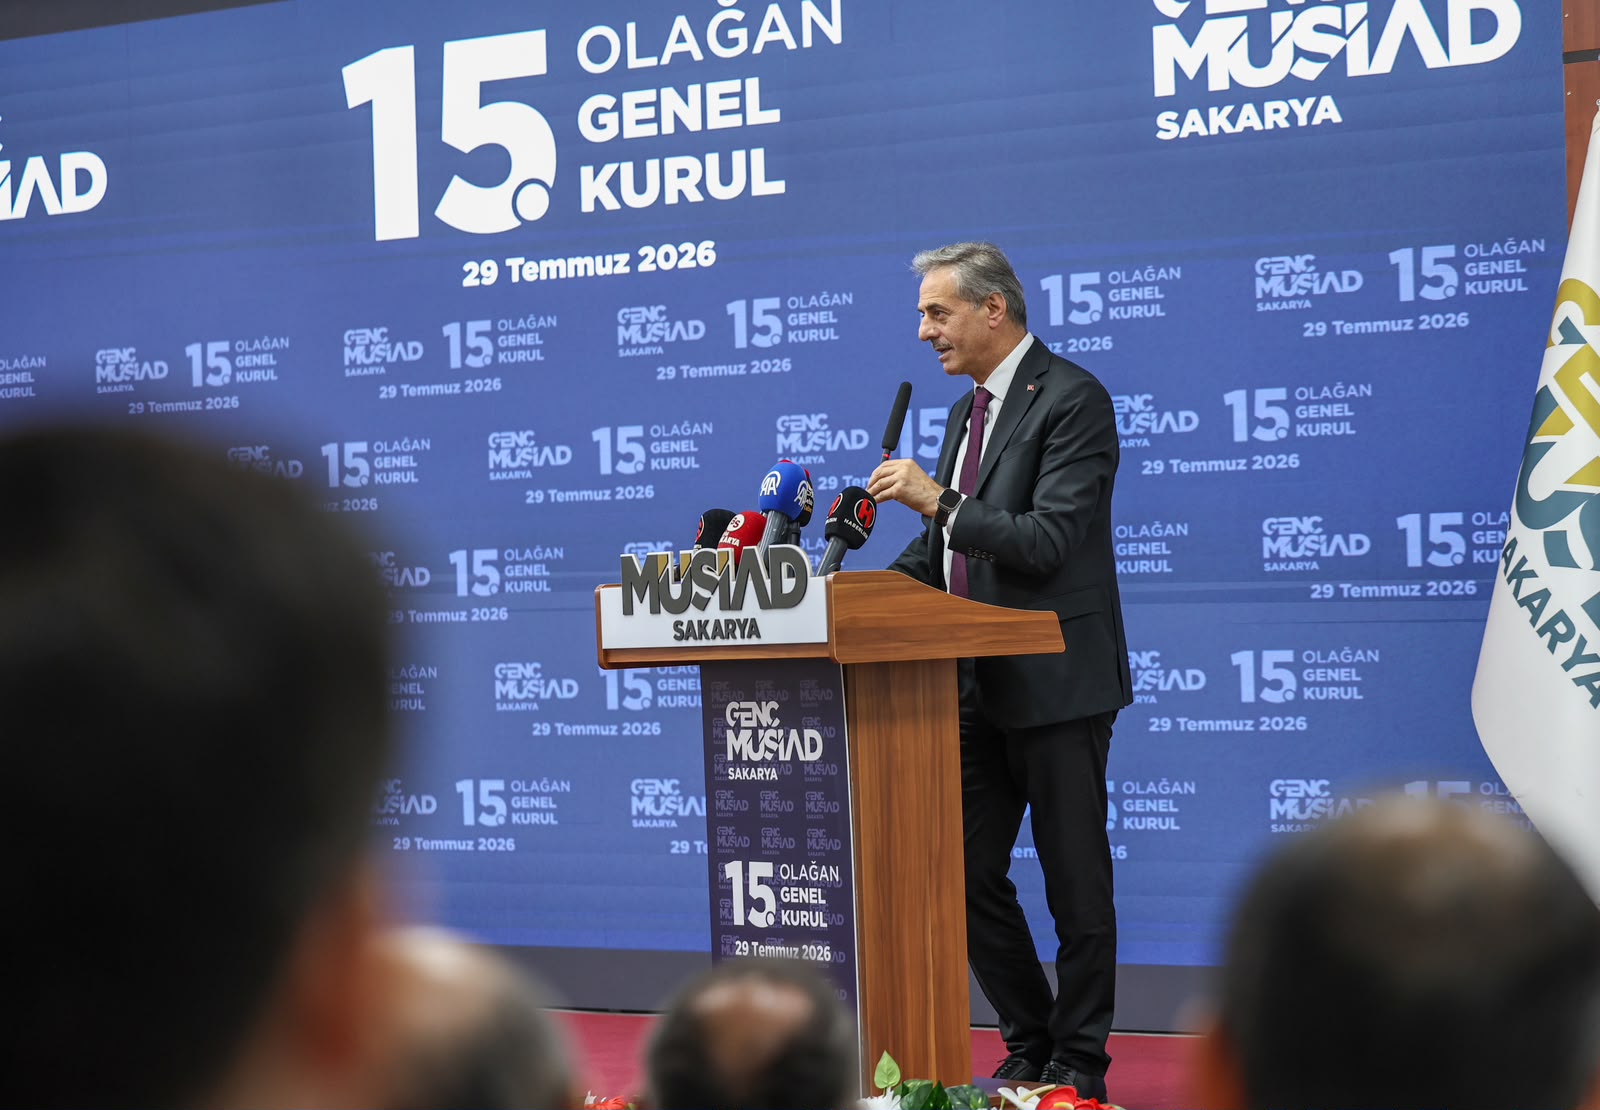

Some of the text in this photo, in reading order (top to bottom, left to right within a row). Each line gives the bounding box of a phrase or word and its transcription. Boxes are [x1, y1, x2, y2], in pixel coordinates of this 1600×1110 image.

[576, 0, 843, 74] OLAĞAN
[577, 77, 781, 143] GENEL
[1156, 95, 1343, 141] SAKARYA
[580, 147, 786, 213] KURUL
[1464, 238, 1544, 257] OLAĞAN
[462, 240, 717, 288] 29 Temmuz 2026
[1465, 260, 1526, 276] GENEL
[1108, 266, 1180, 284] OLAĞAN
[1466, 278, 1528, 294] KURUL
[788, 292, 852, 309] OLAĞAN
[1109, 286, 1164, 302] GENEL
[1109, 304, 1166, 320] KURUL
[1257, 300, 1312, 311] SAKARYA
[498, 314, 556, 331] OLAĞAN
[788, 311, 838, 326] GENEL
[1304, 312, 1469, 336] 29 Temmuz 2026
[498, 332, 543, 347] GENEL
[788, 328, 839, 342] KURUL
[235, 336, 289, 352] OLAĞAN
[618, 346, 664, 357] SAKARYA
[1068, 336, 1112, 352] 2026
[236, 354, 276, 367] GENEL
[499, 349, 544, 363] KURUL
[236, 369, 278, 382] KURUL
[345, 366, 386, 376] SAKARYA
[657, 358, 791, 380] 29 Temmuz 2026
[97, 385, 134, 394] SAKARYA
[380, 378, 501, 398] 29 Temmuz 2026
[1295, 382, 1372, 400] OLAĞAN
[129, 396, 239, 414] 29 Temmuz 2026
[1296, 404, 1354, 418] GENEL
[650, 421, 712, 437] OLAĞAN
[1296, 422, 1356, 436] KURUL
[374, 437, 430, 453] OLAĞAN
[650, 440, 698, 453] GENEL
[374, 456, 417, 468] GENEL
[651, 456, 700, 470] KURUL
[1142, 454, 1300, 474] 29 Temmuz 2026
[375, 471, 418, 484] KURUL
[490, 470, 532, 480] SAKARYA
[818, 476, 838, 490] 29
[526, 485, 654, 503] 29 Temmuz 2026
[344, 498, 378, 510] 2026
[1472, 511, 1509, 526] OLA
[1115, 521, 1188, 538] OLAĞAN
[1472, 530, 1506, 544] GEN
[504, 545, 563, 561] OLAĞAN
[1116, 542, 1171, 556] GENEL
[505, 564, 550, 577] GENEL
[1116, 560, 1172, 574] KURUL
[1264, 562, 1319, 572] SAKARYA
[505, 580, 551, 592] KURUL
[1310, 580, 1476, 598] 29 Temmuz 2026
[408, 610, 467, 622] Temmuz
[472, 607, 508, 621] 2026
[672, 618, 761, 641] SAKARYA
[1502, 536, 1600, 709] AKARYA
[1302, 647, 1379, 663] OLAĞAN
[1303, 668, 1362, 681] GENEL
[1304, 687, 1363, 700] KURUL
[496, 702, 538, 710] SAKARYA
[532, 722, 661, 736] 29 Temmuz 2026
[1149, 716, 1307, 731] 29 Temmuz 2026
[728, 767, 778, 780] SAKARYA
[511, 778, 570, 792] OLAĞAN
[1122, 778, 1195, 794] OLAĞAN
[512, 796, 557, 808] GENEL
[1123, 800, 1178, 812] GENEL
[512, 812, 558, 824] KURUL
[632, 819, 677, 828] SAKARYA
[1124, 817, 1180, 830] KURUL
[394, 838, 515, 851] 29 Temmuz 2026
[670, 840, 690, 853] 29
[780, 861, 839, 881] OLAĞAN
[780, 887, 826, 904] GENEL
[781, 909, 828, 927] KURUL
[735, 940, 832, 962] 29 Temmuz 2026
